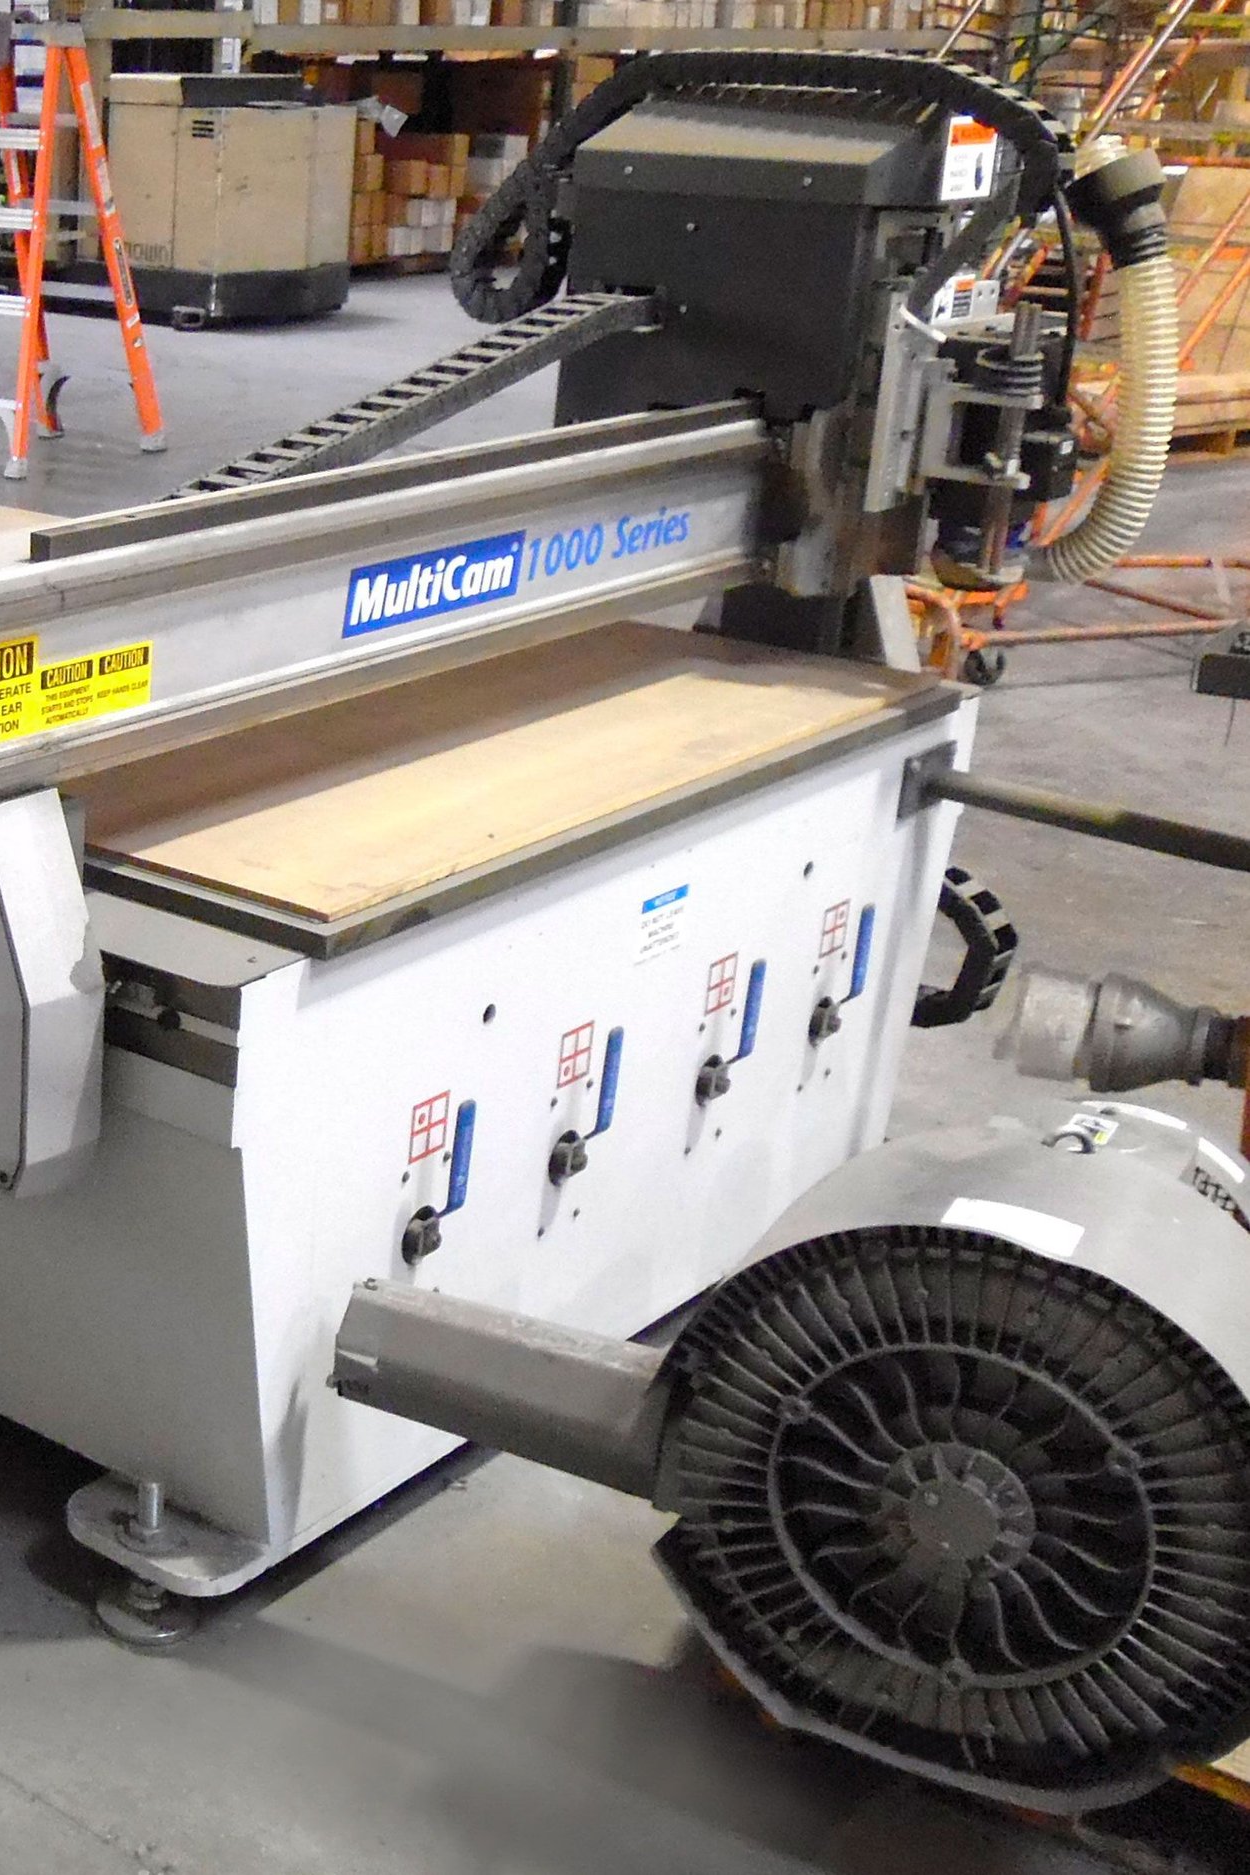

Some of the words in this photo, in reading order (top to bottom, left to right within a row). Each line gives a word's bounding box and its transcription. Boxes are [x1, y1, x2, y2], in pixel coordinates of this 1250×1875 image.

[349, 554, 515, 626] MultiCam
[527, 522, 605, 582] 1000
[611, 506, 690, 559] Series
[104, 647, 145, 673] CAUTION
[46, 661, 89, 688] CAUTION
[1, 701, 23, 717] EAR
